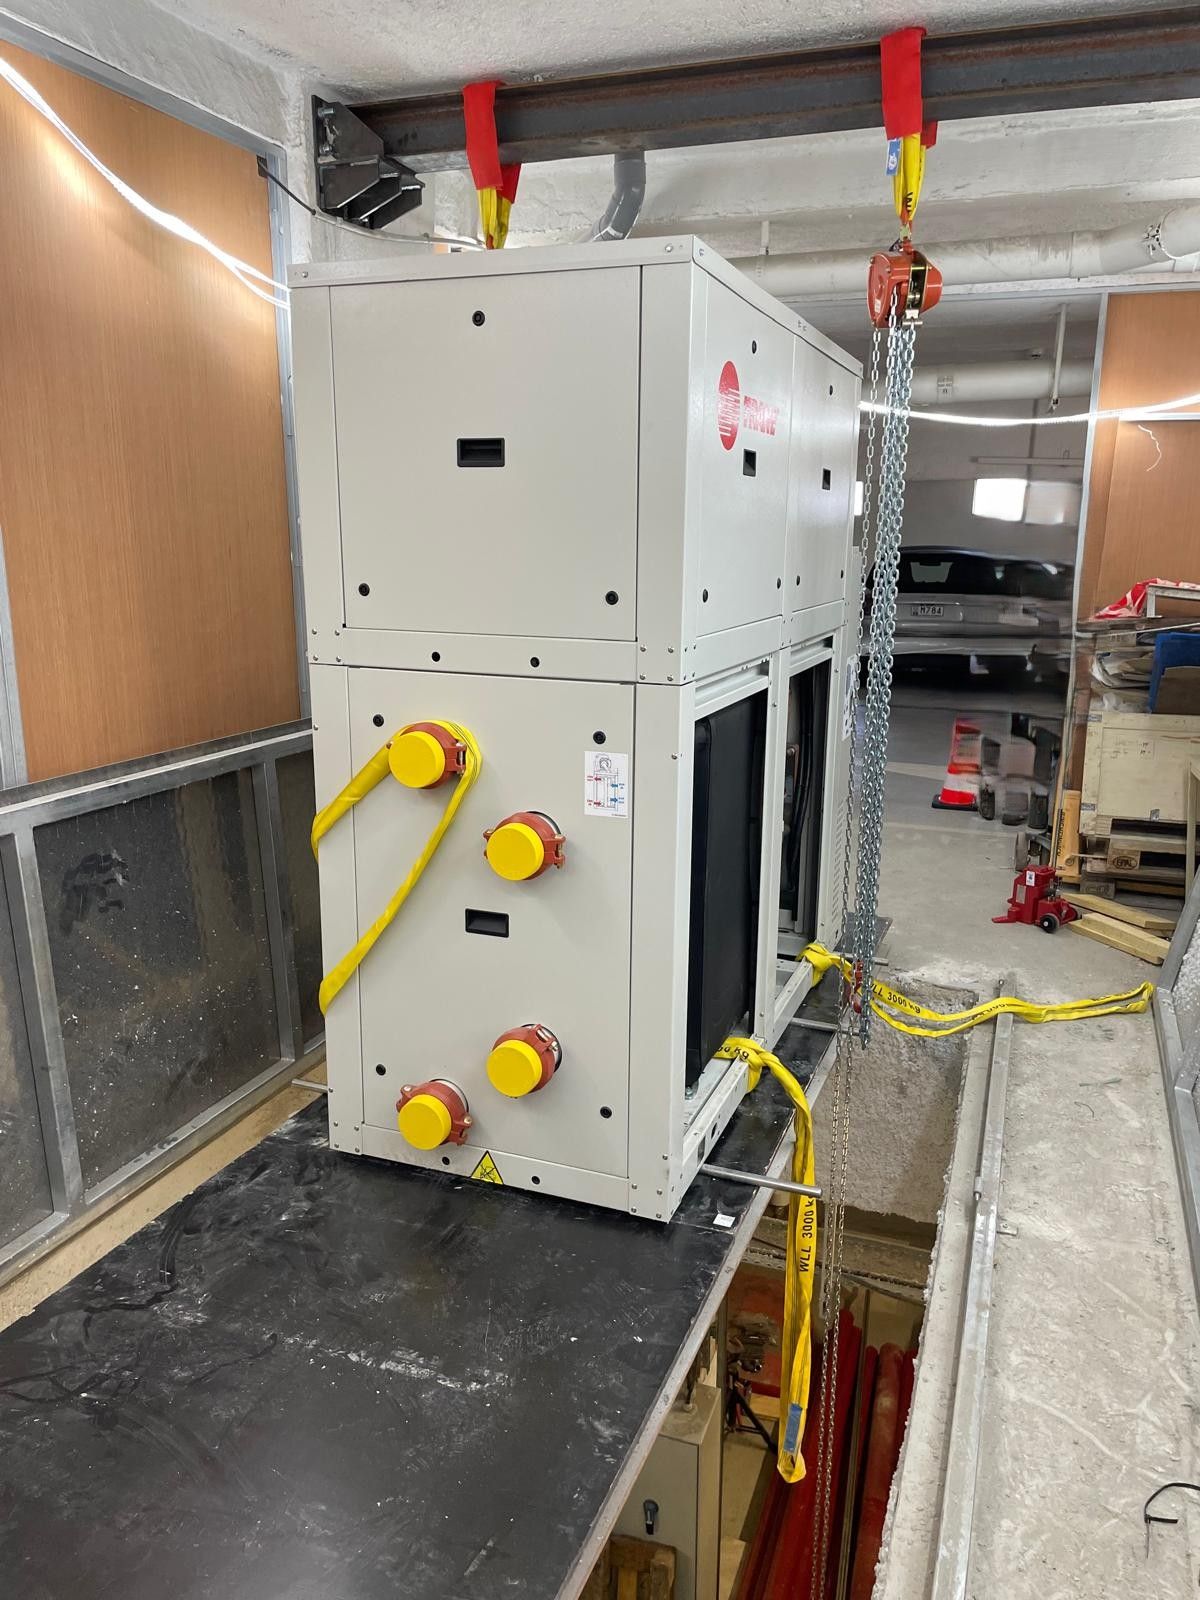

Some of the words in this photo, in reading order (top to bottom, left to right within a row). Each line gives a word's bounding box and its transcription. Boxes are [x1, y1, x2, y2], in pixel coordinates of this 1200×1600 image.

[744, 395, 779, 437] TRANE
[887, 990, 908, 1008] 3000
[908, 1001, 921, 1014] kg
[734, 1046, 750, 1062] kg
[802, 1210, 815, 1239] 3000
[800, 1245, 812, 1272] WLL
